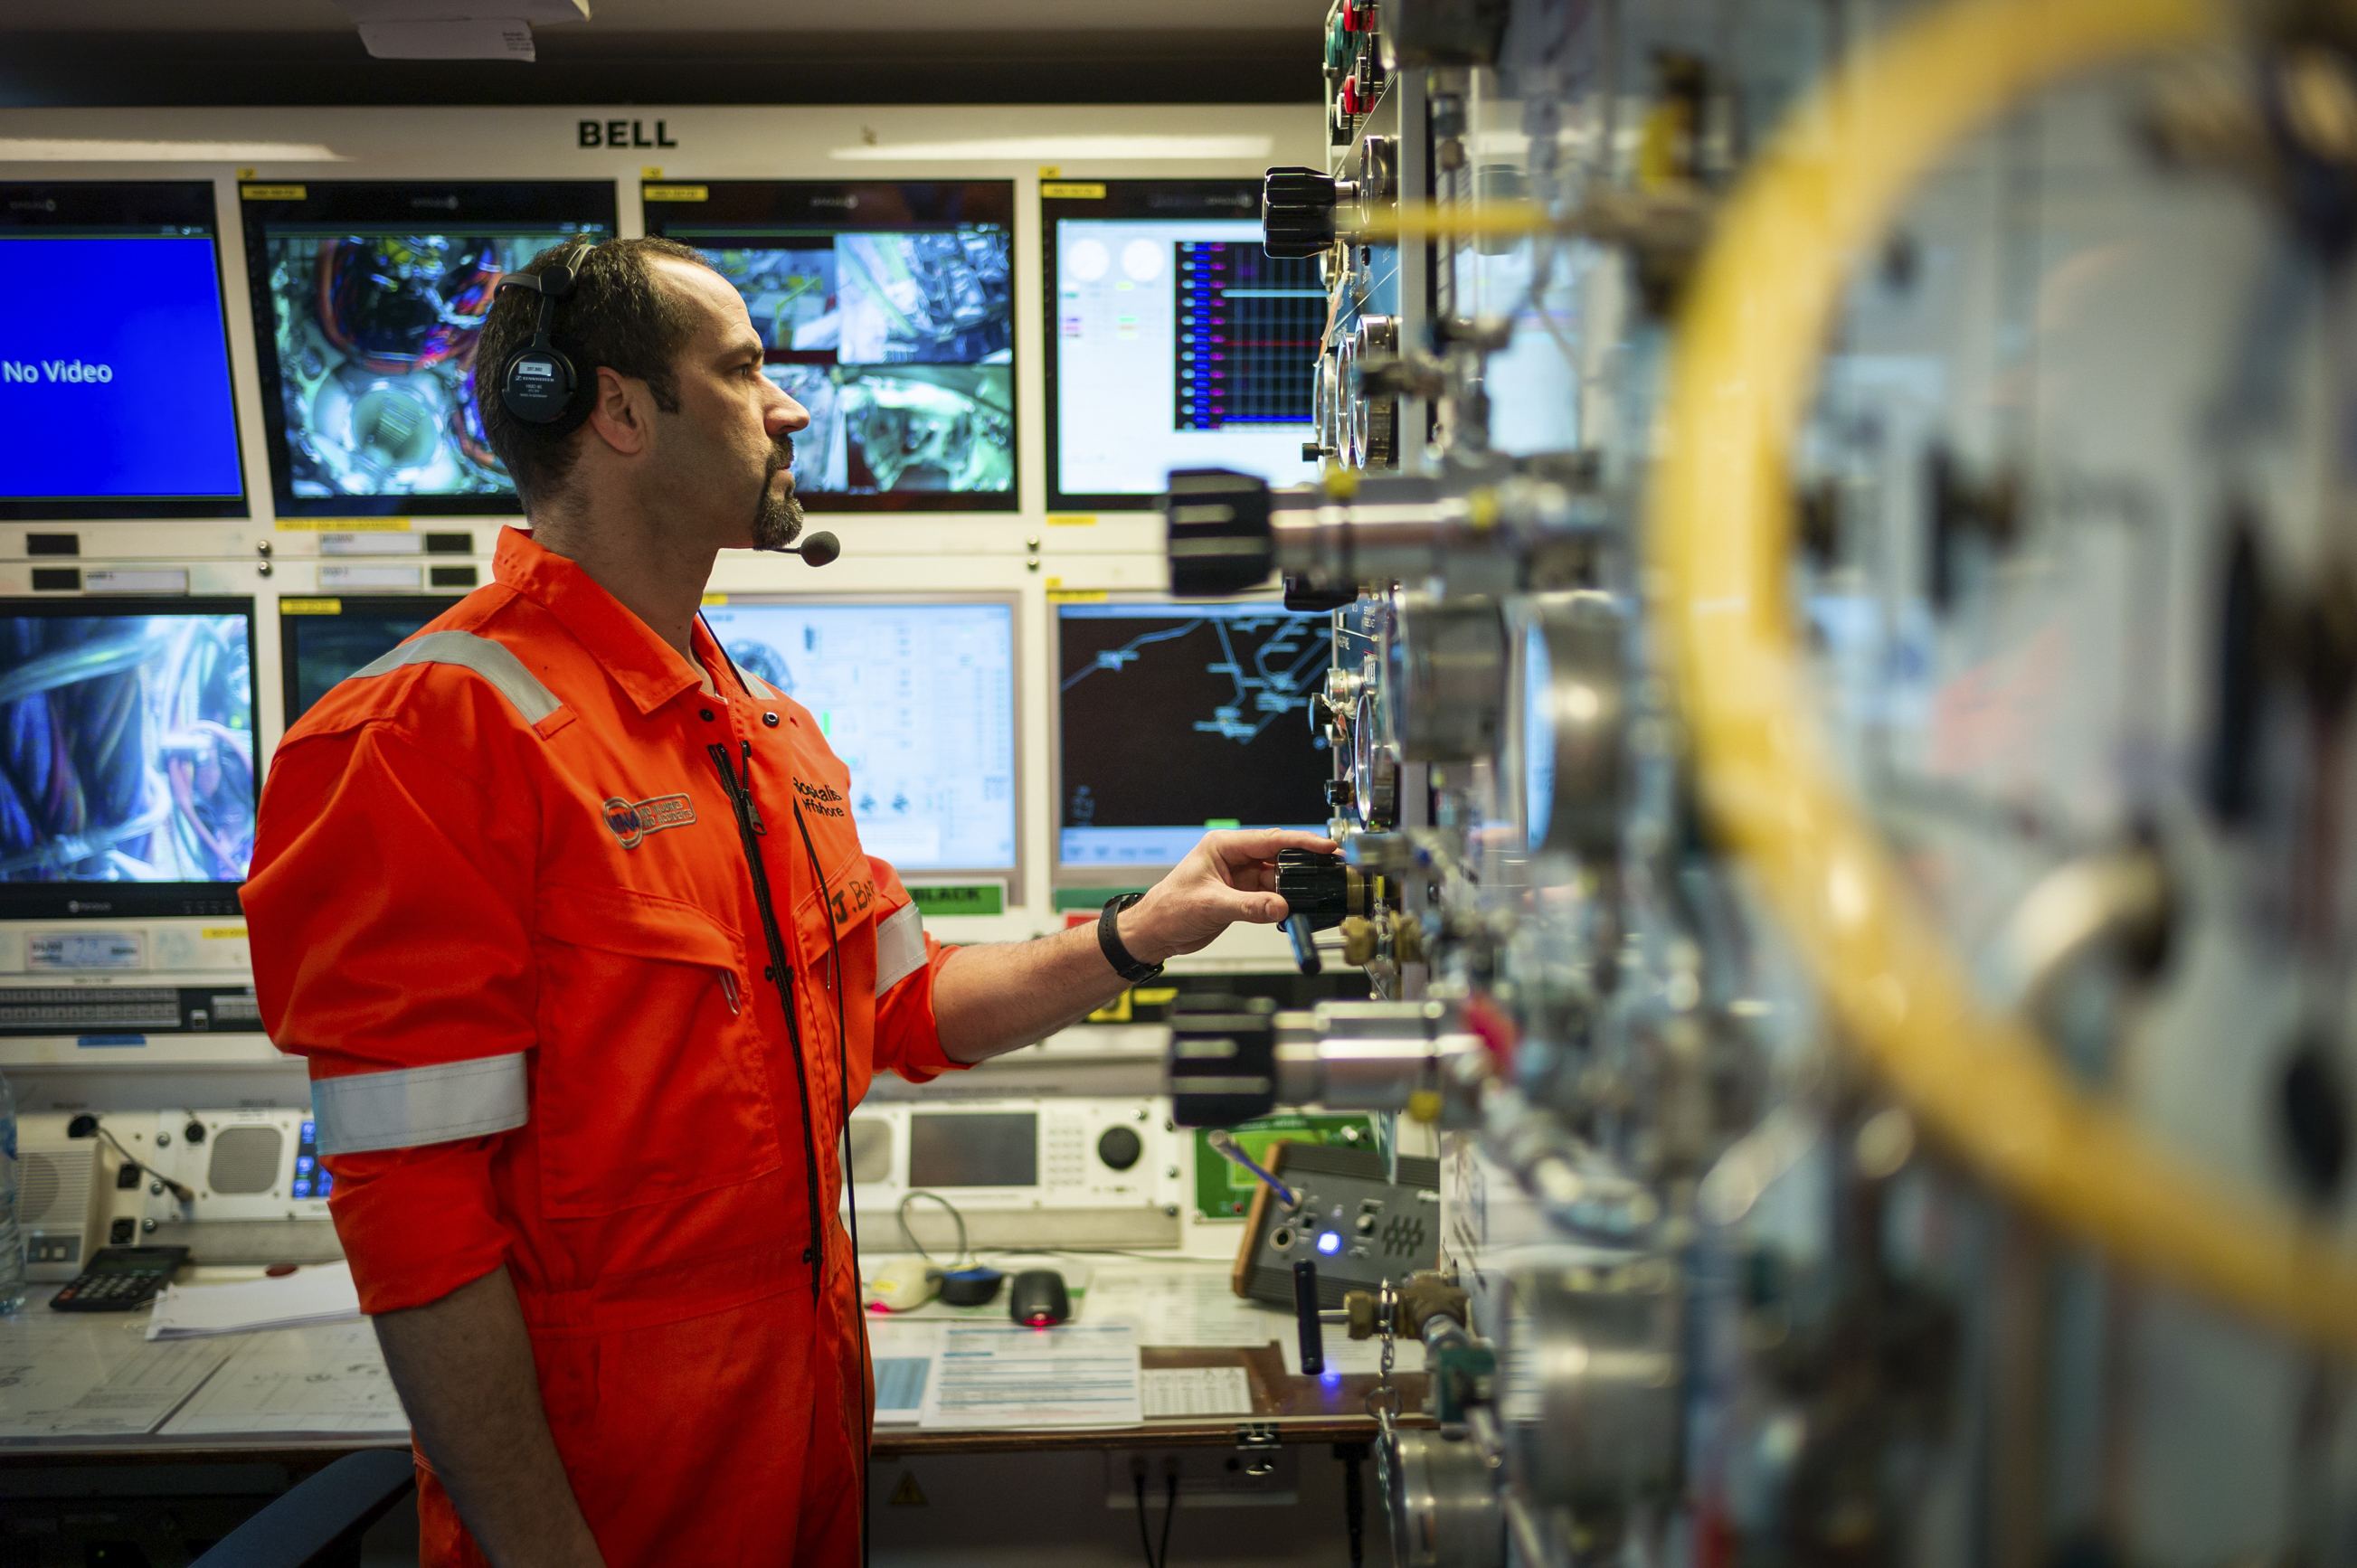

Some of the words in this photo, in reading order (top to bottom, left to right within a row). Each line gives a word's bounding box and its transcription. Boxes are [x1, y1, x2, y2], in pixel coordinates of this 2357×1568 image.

[578, 119, 678, 148] BELL
[2, 360, 39, 383] No
[41, 359, 113, 383] Video
[801, 798, 845, 817] ffshore
